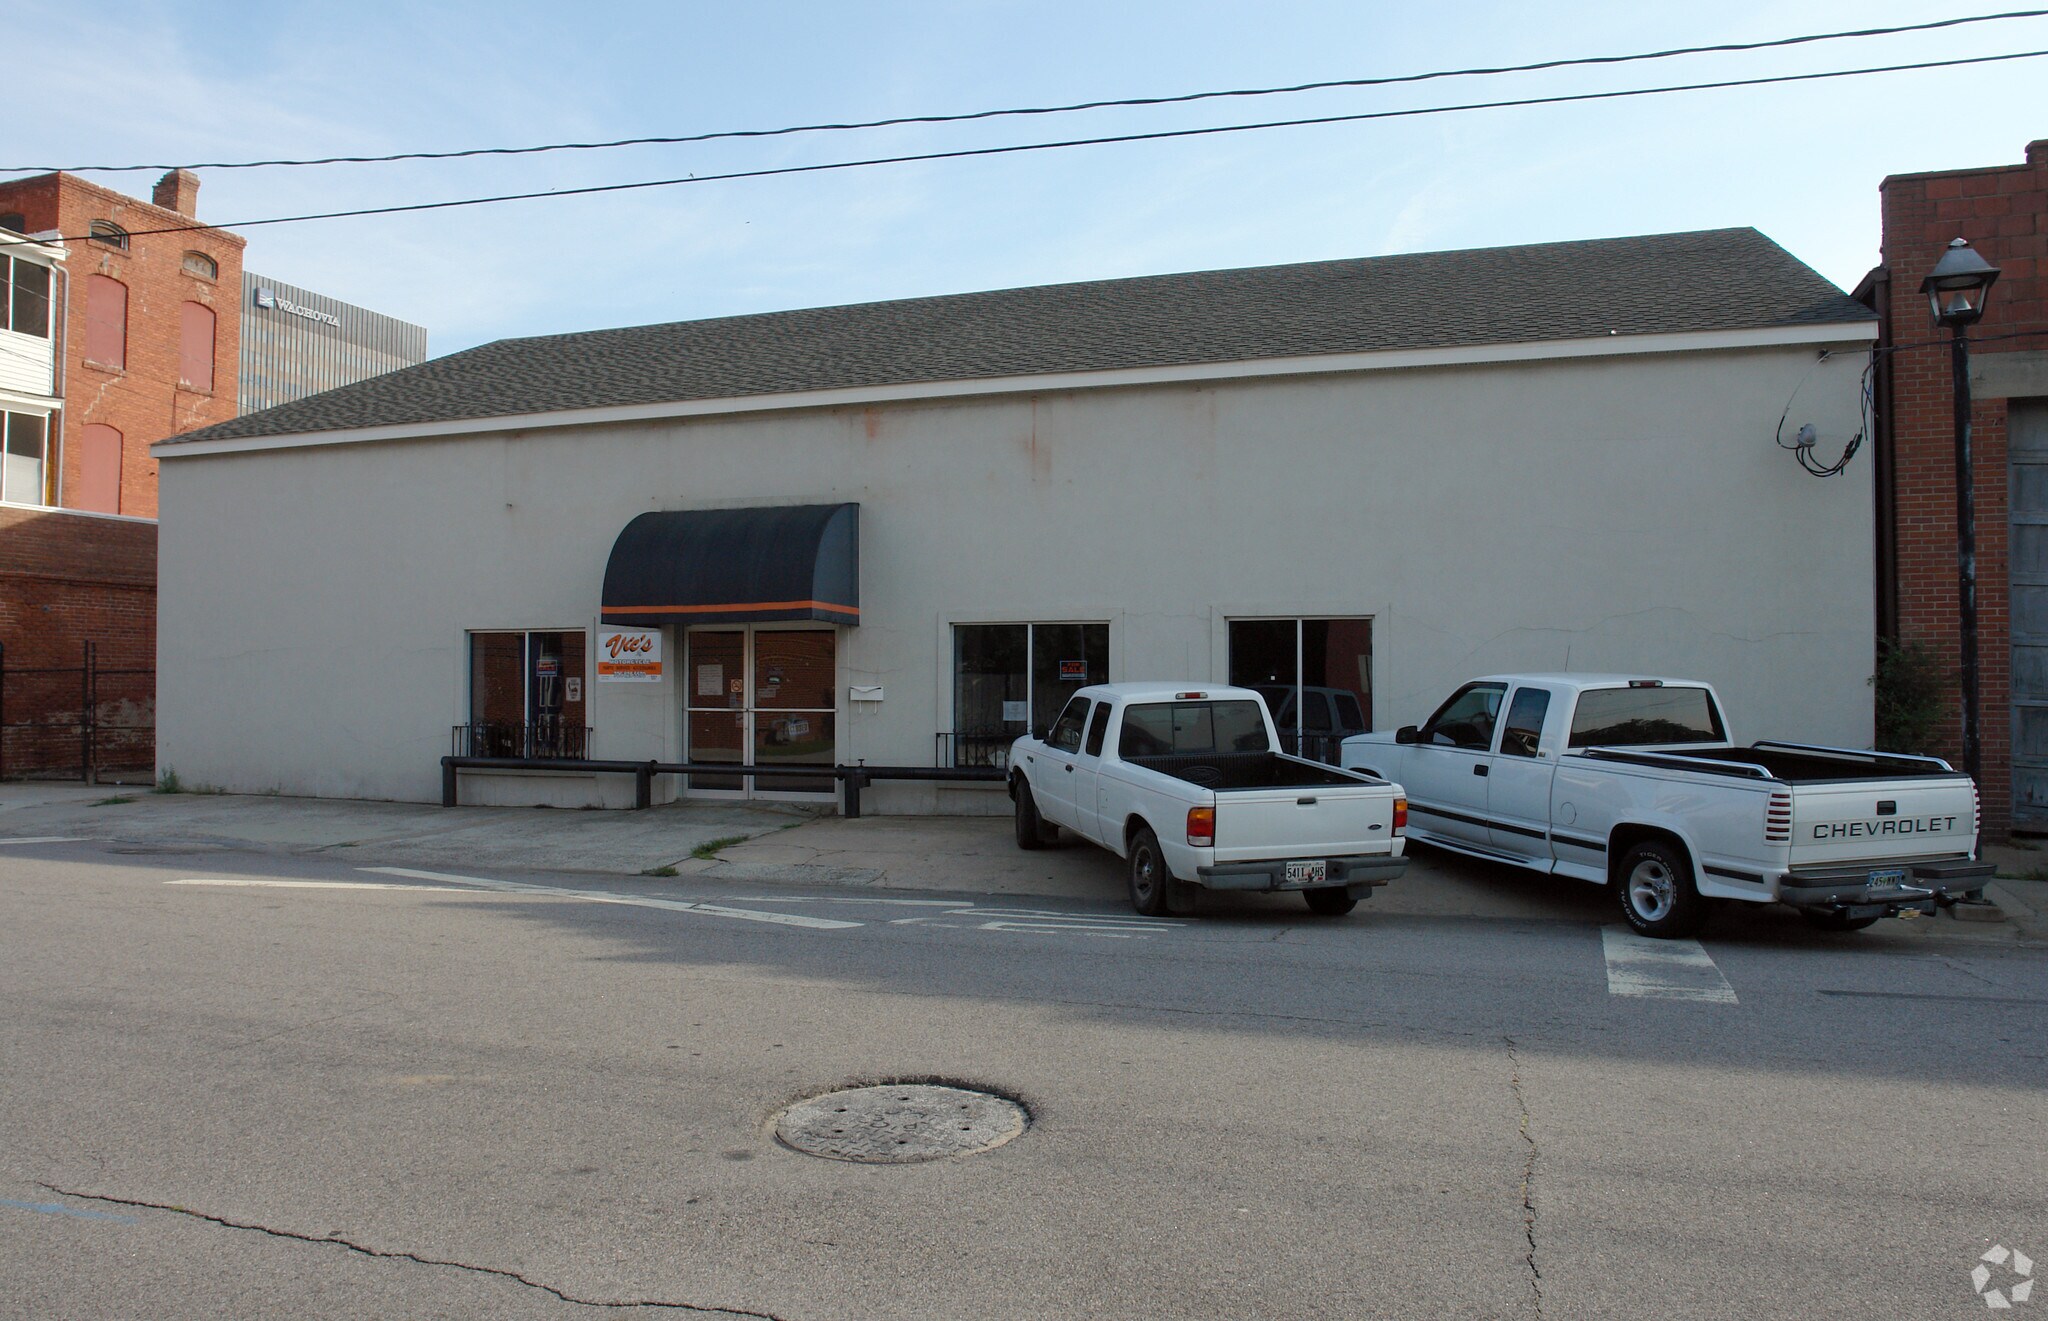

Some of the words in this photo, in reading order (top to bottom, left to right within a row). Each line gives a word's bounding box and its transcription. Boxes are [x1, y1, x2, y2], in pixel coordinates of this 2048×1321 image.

[275, 297, 341, 327] WACHOVIA
[606, 634, 653, 658] Vic's
[1813, 816, 1957, 839] CHEVROLET
